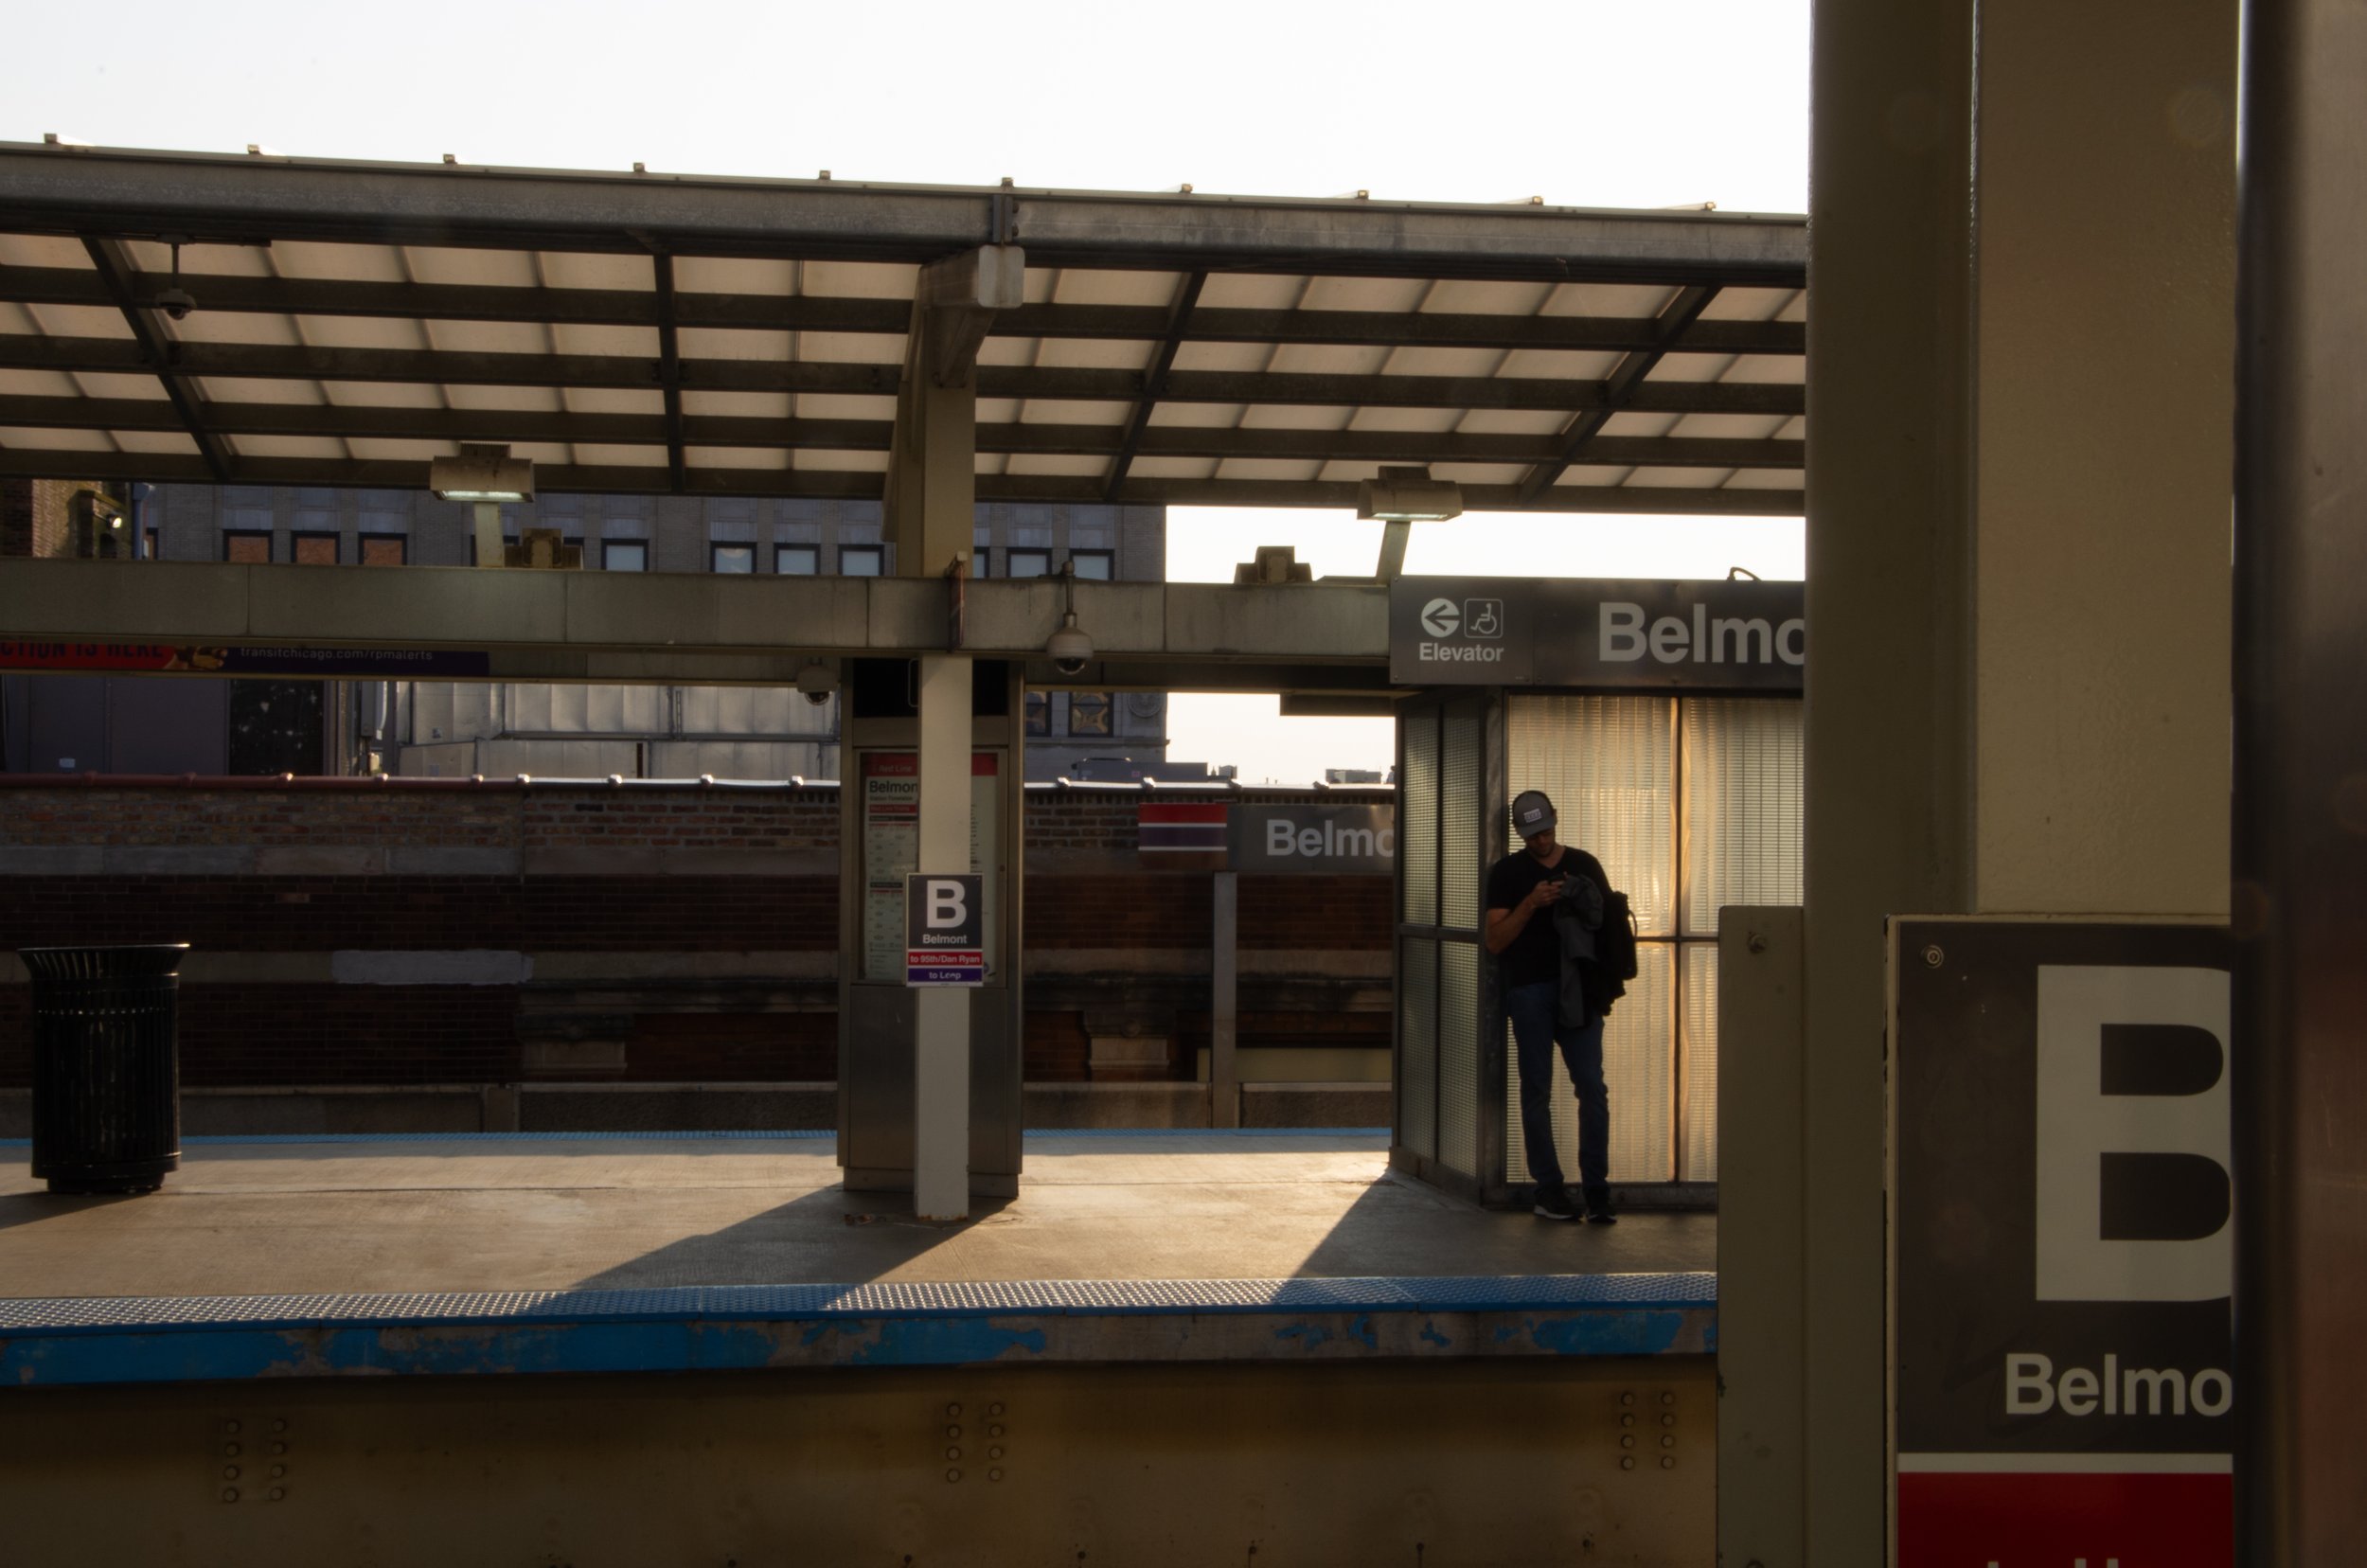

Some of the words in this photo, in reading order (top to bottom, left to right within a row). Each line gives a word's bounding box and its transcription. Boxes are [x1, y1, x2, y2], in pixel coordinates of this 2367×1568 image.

[1598, 601, 1805, 665] Belmo
[240, 647, 433, 662] transitchicago.com/rpmalerts
[1419, 642, 1504, 663] Elevator
[1267, 819, 1394, 857] Belmo
[926, 880, 967, 928] B
[922, 934, 968, 944] Belmont
[910, 954, 918, 963] to
[920, 954, 956, 963] 95th/Dan
[959, 954, 980, 965] Ryan
[2036, 964, 2232, 1302] B
[2005, 1353, 2233, 1417] Belmo
